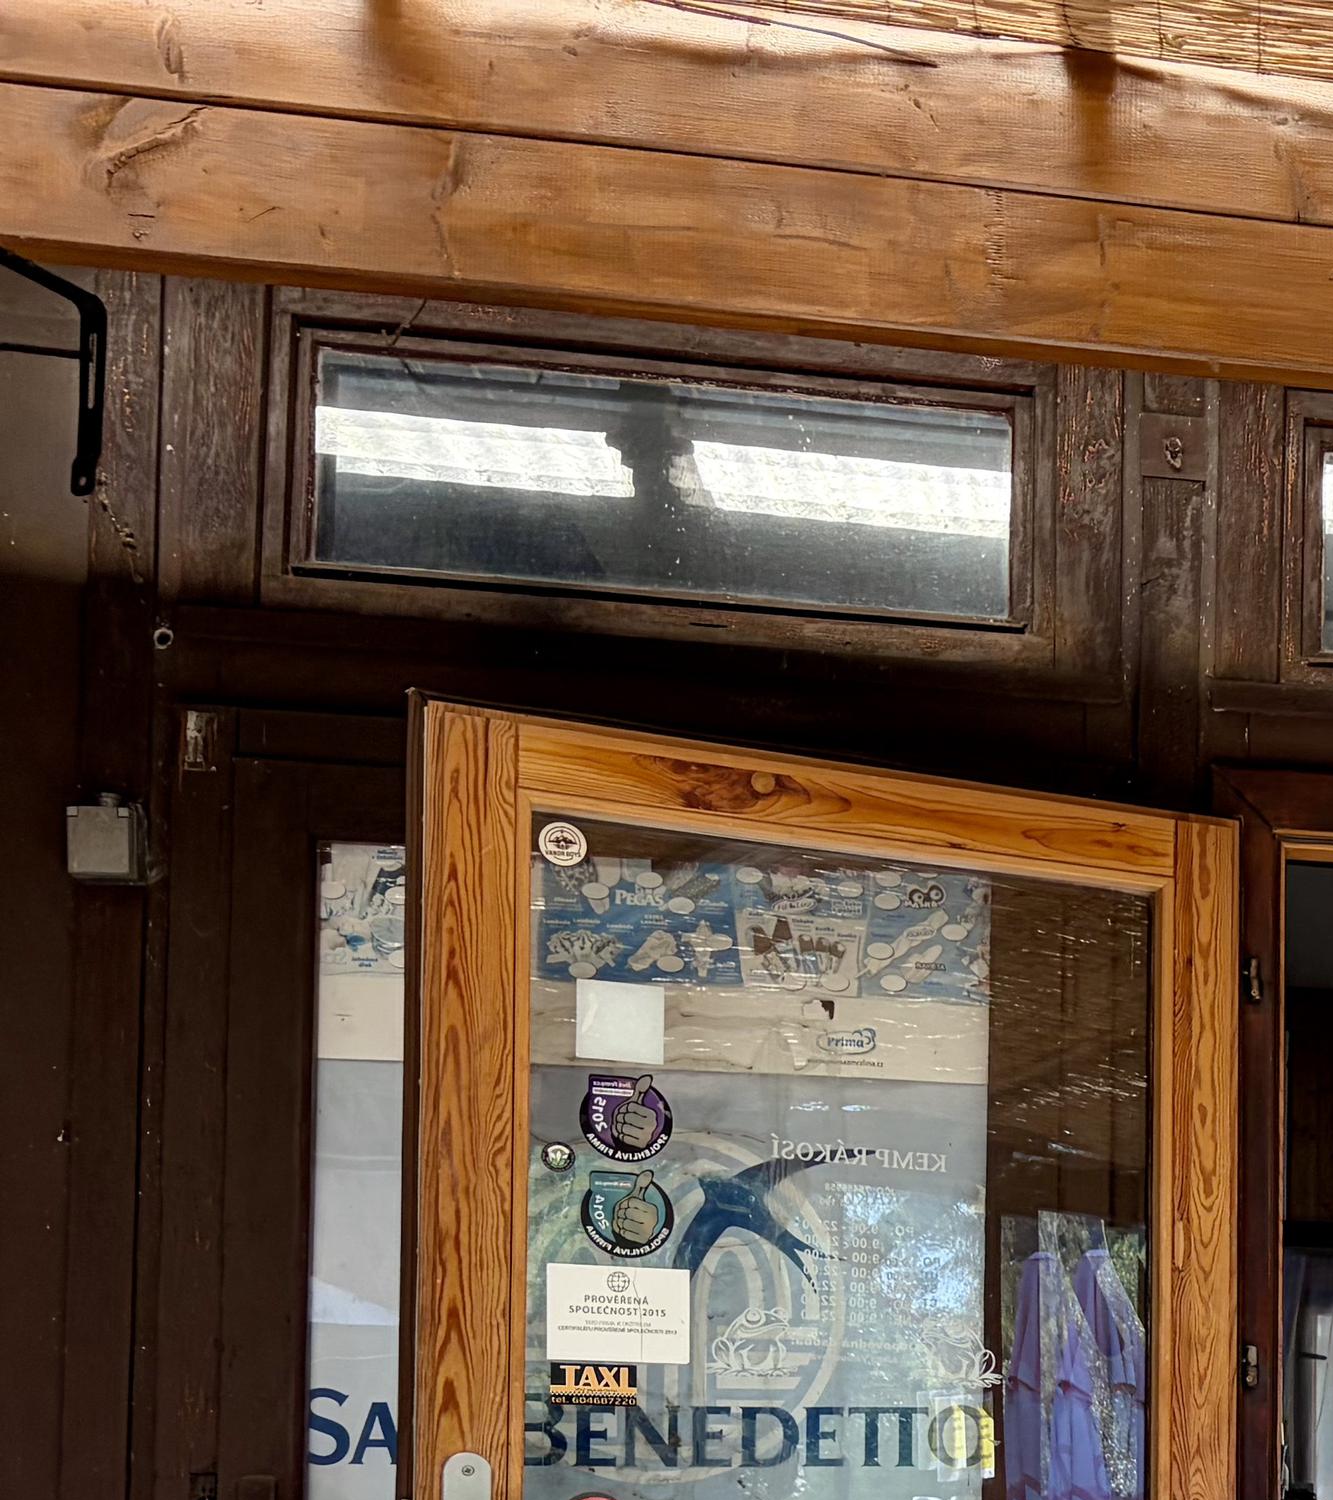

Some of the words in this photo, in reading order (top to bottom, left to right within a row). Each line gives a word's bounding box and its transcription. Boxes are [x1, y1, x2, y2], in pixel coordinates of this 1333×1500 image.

[584, 1294, 649, 1305] PROVĚŘENÁ
[569, 1305, 638, 1316] SPOLEČNOST
[642, 1308, 666, 1317] 2015
[560, 1365, 630, 1388] TAXI
[552, 1396, 570, 1404] tel.
[309, 1388, 397, 1465] SA
[524, 1393, 984, 1468] BENEDETTO
